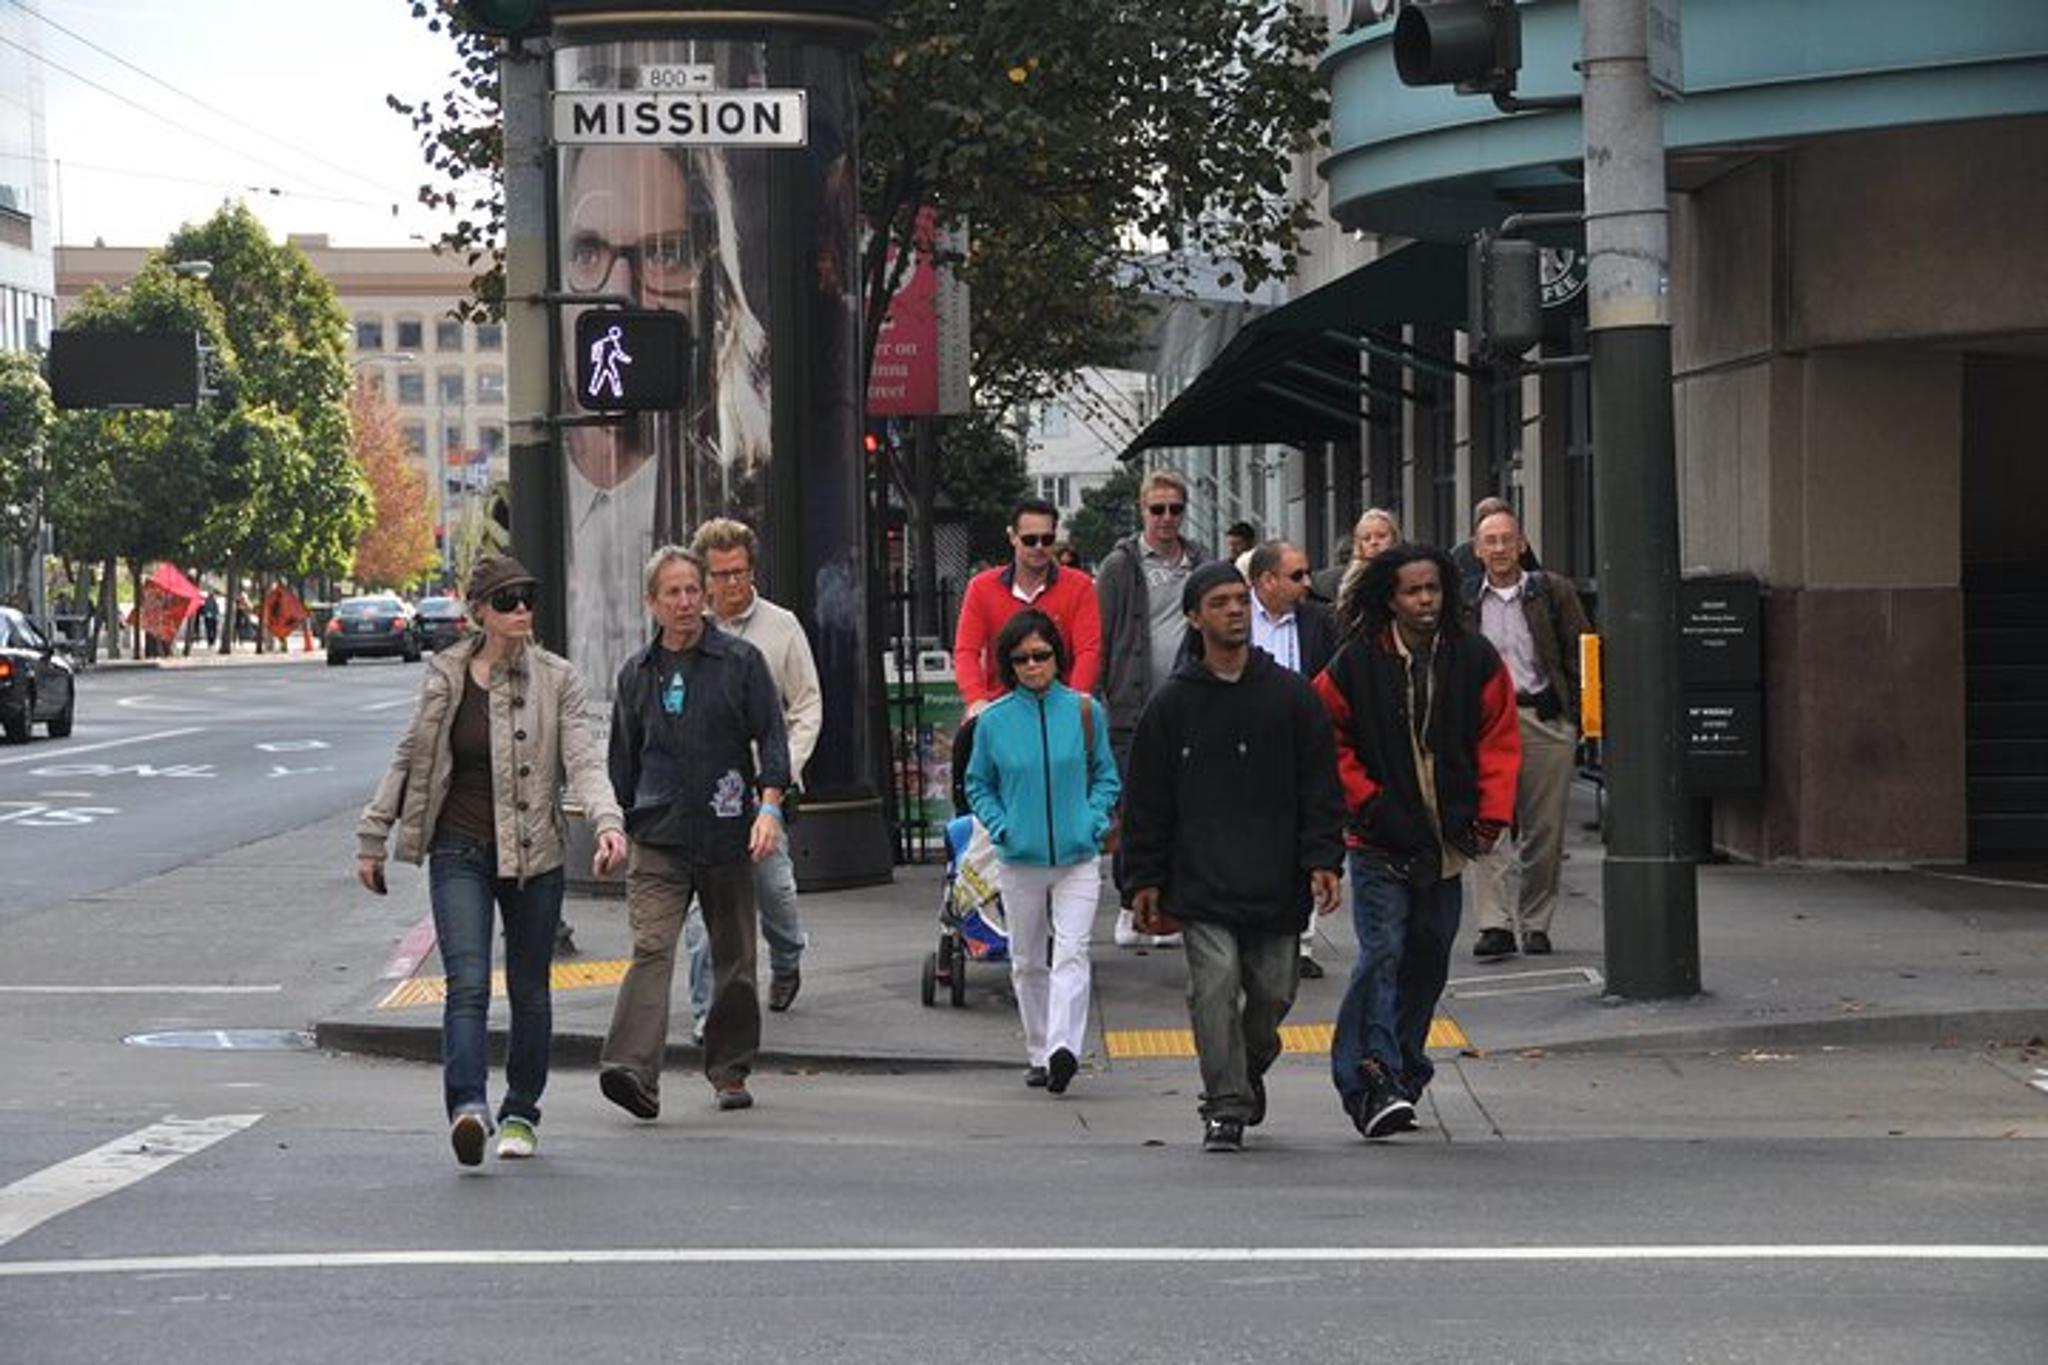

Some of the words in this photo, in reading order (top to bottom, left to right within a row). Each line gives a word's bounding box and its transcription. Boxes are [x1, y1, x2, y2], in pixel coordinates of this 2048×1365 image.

[650, 69, 686, 86] 800
[573, 102, 781, 135] MISSION
[1543, 275, 1580, 302] FEE
